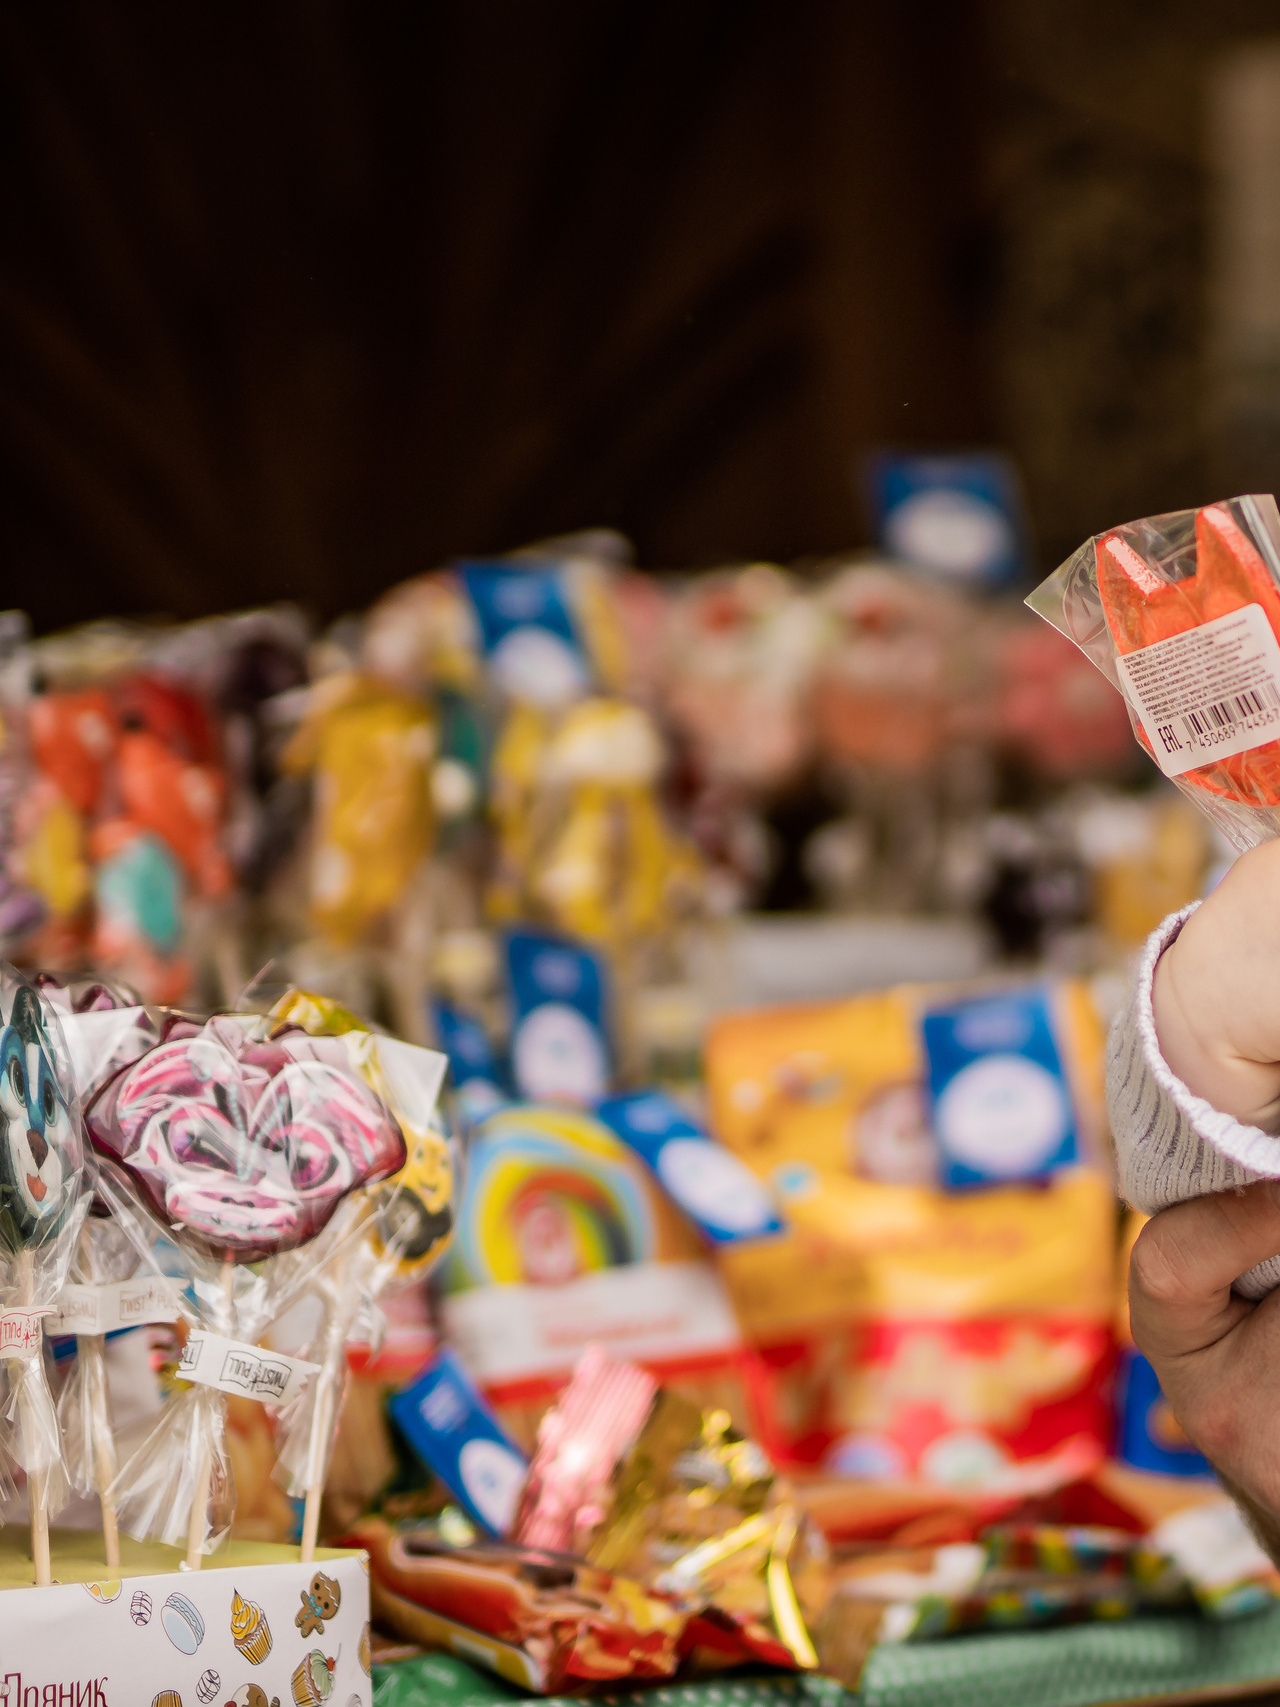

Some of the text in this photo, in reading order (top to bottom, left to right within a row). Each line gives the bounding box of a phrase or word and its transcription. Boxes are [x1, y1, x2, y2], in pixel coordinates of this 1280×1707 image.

[1186, 708, 1280, 753] 7 450689 744567
[4, 1321, 22, 1339] PULL
[229, 1357, 288, 1390] TWIST PULL
[0, 1672, 109, 1707] Пряник
